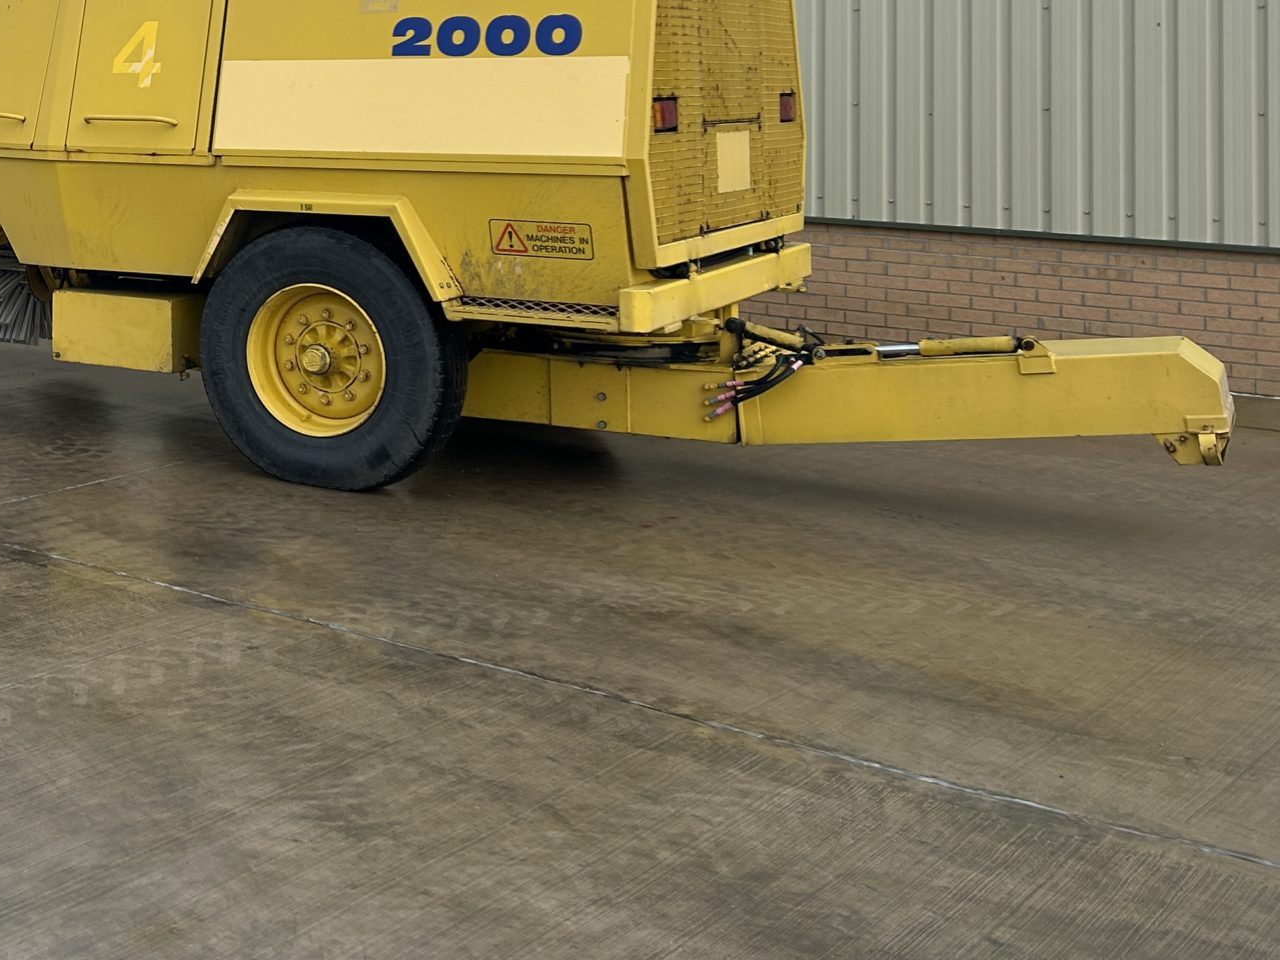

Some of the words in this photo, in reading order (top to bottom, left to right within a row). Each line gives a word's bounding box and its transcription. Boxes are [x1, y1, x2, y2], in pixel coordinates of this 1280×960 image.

[391, 14, 583, 57] 2000
[111, 20, 162, 89] 4
[536, 224, 576, 235] DANGER
[526, 234, 575, 245] MACHINES
[579, 237, 589, 245] IN
[532, 244, 585, 255] OPERATION
